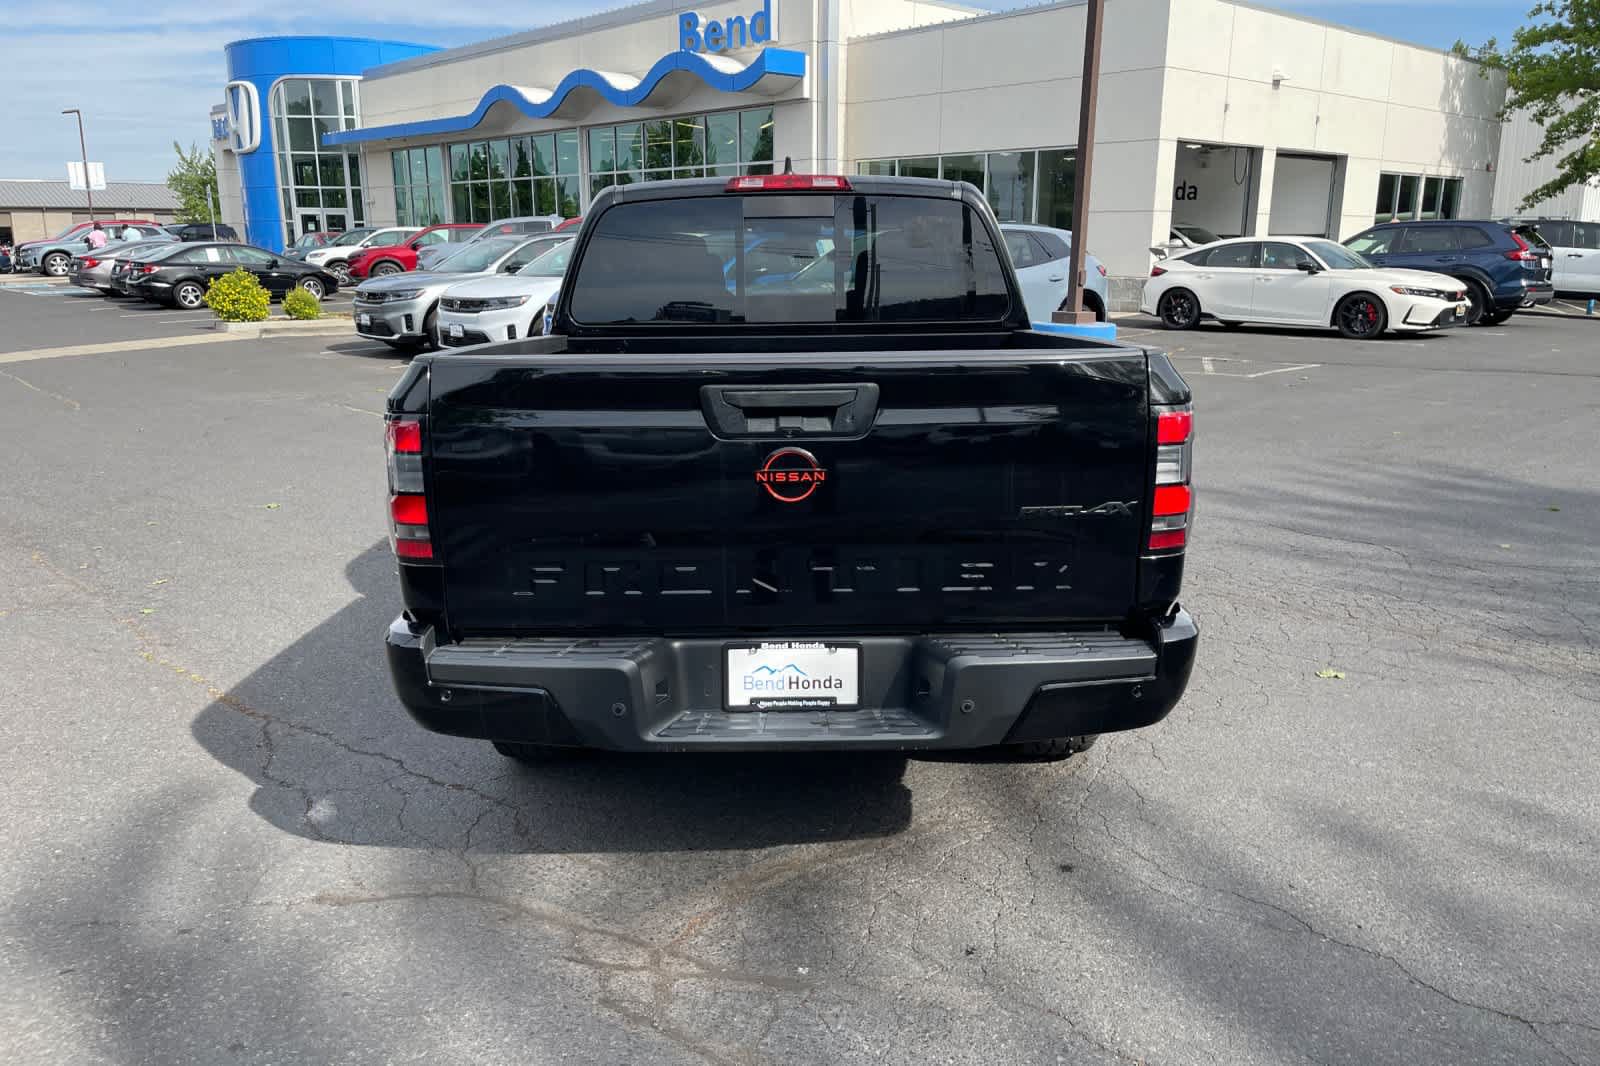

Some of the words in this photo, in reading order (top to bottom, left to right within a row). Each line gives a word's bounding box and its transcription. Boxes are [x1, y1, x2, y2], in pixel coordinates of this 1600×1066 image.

[679, 0, 772, 53] Bend
[1175, 179, 1198, 200] da
[755, 471, 826, 482] NISSAN
[761, 642, 789, 650] Bend
[791, 642, 825, 650] Honda
[788, 675, 843, 690] Honda
